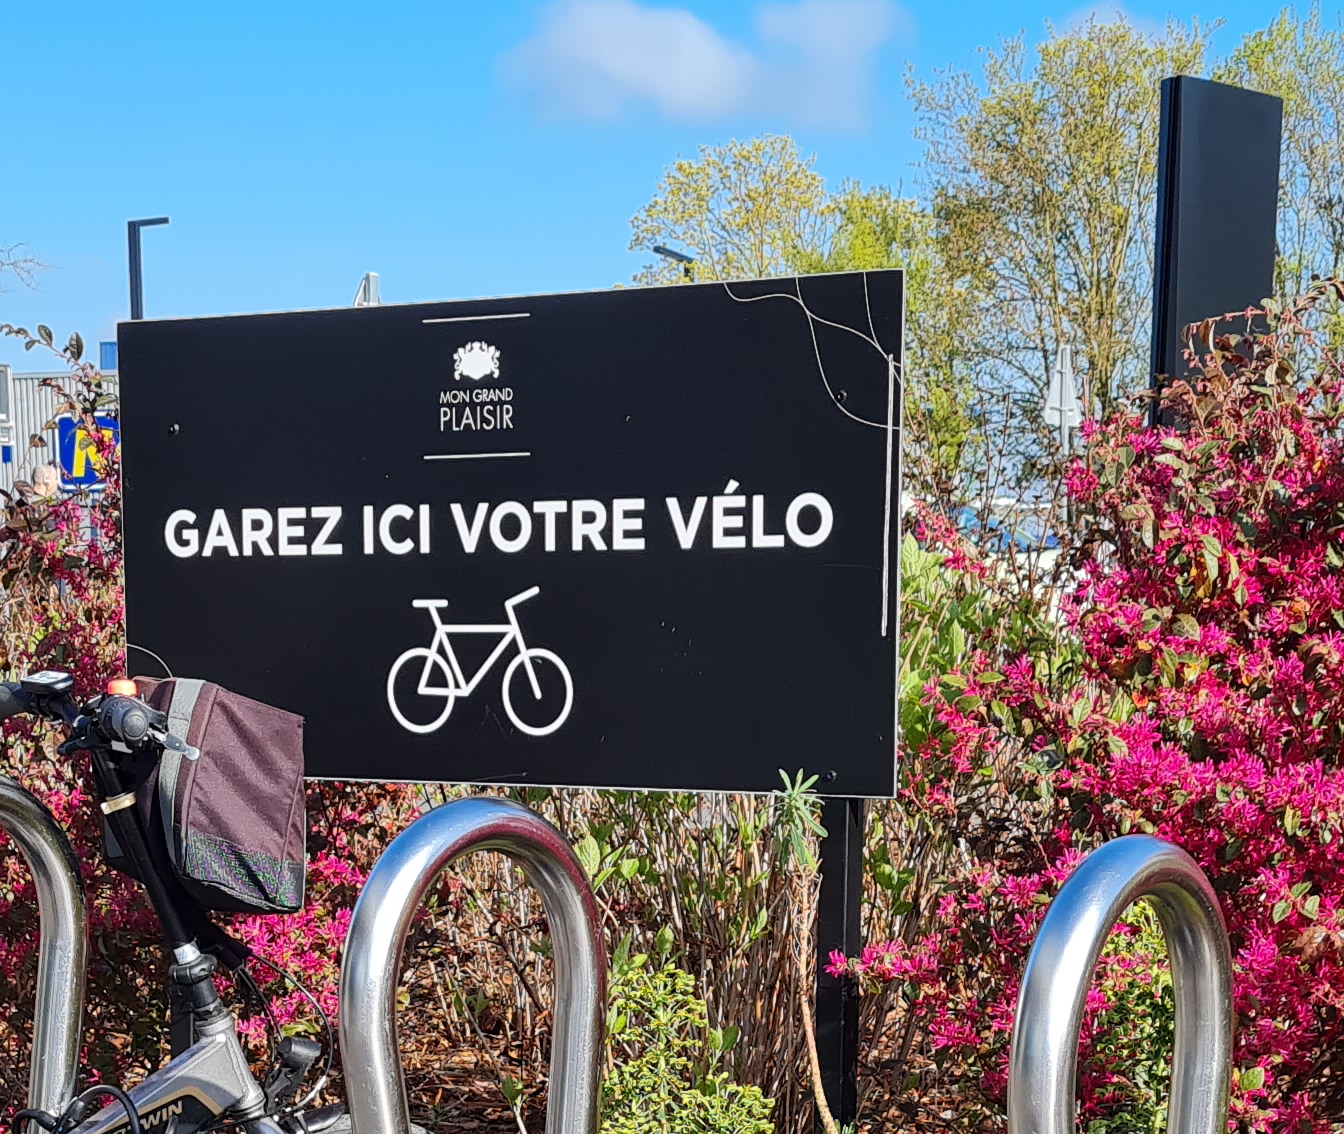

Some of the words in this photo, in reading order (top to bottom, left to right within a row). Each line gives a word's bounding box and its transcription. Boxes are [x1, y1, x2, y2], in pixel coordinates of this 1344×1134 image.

[439, 388, 470, 404] MON
[472, 387, 514, 403] GRAND
[440, 404, 514, 432] PLAISIR
[164, 506, 342, 557] GAREZ
[363, 503, 430, 554] ICI
[449, 497, 645, 553] VOTRE
[665, 478, 833, 549] VÉLO
